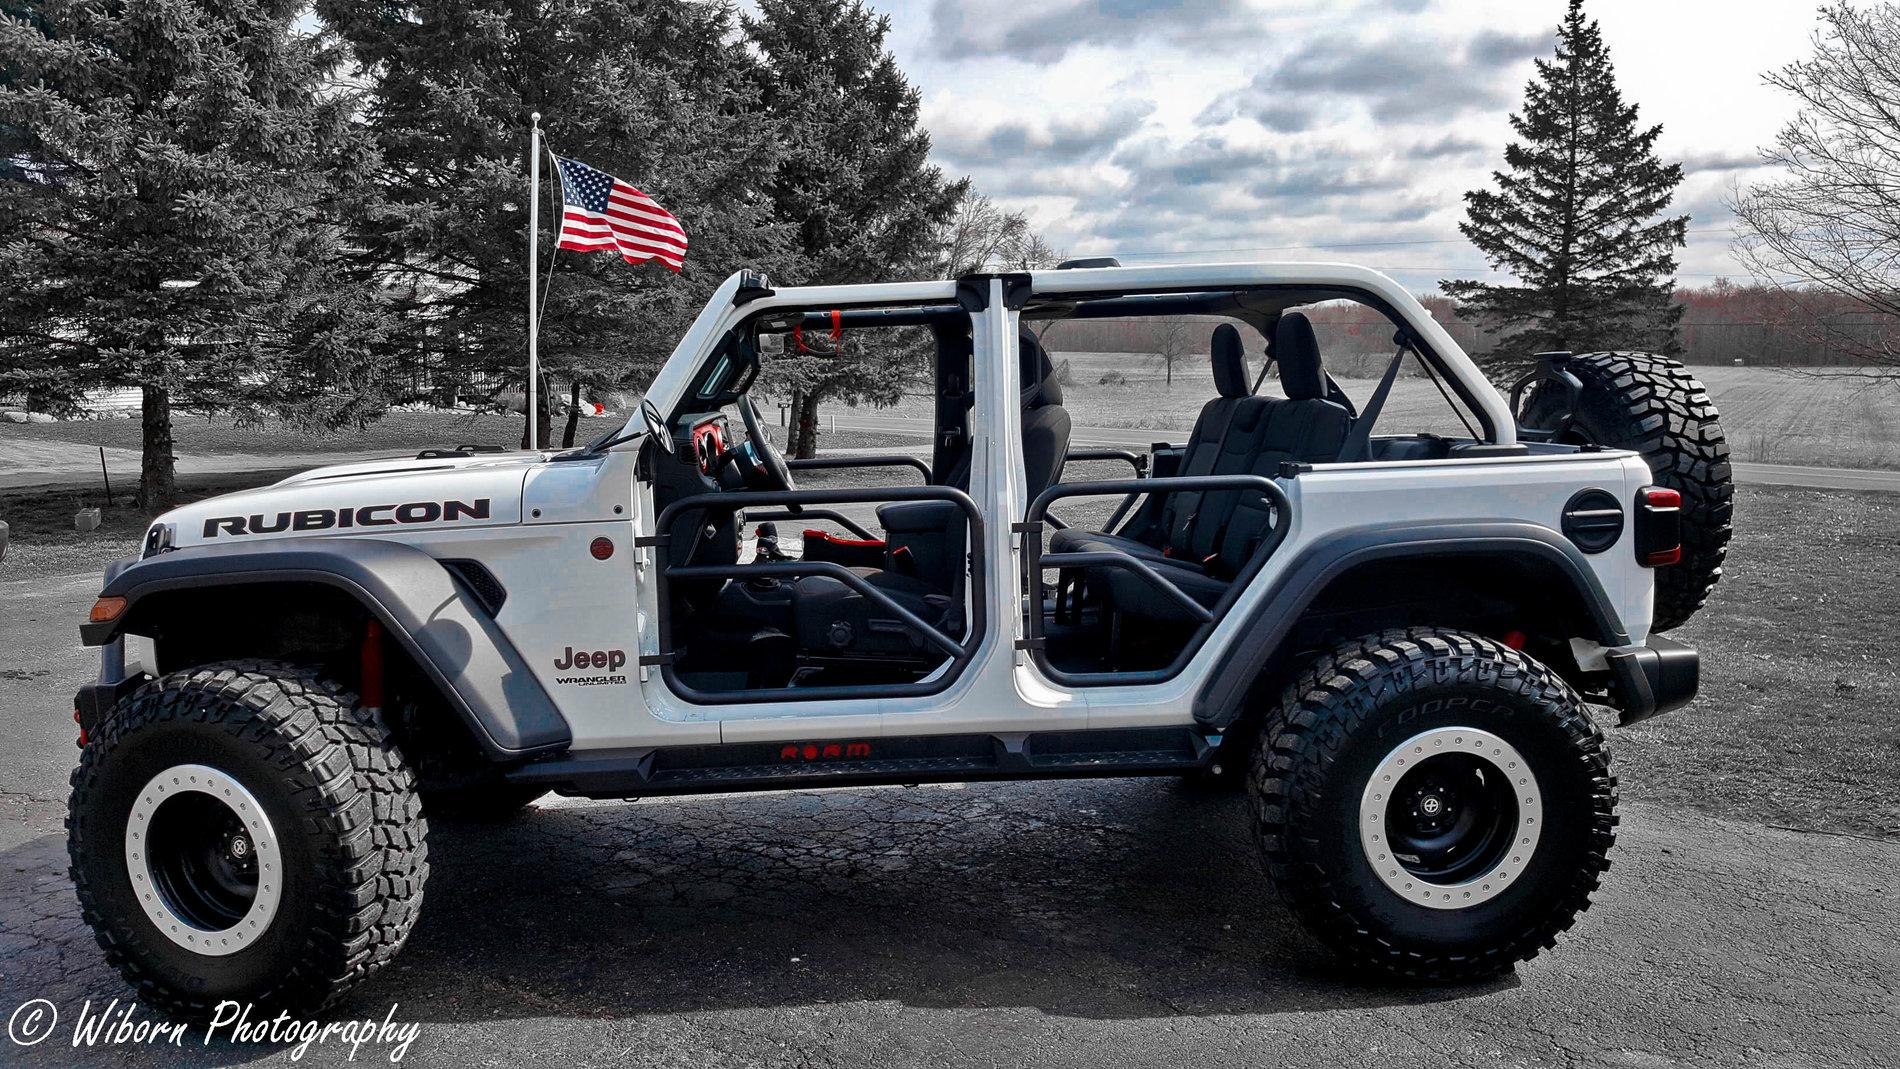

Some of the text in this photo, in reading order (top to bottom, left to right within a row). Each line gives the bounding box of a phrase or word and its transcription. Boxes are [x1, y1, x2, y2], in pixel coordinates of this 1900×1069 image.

[203, 498, 491, 538] RUBICON
[554, 646, 626, 673] Jeep
[556, 675, 627, 685] WRANGLER
